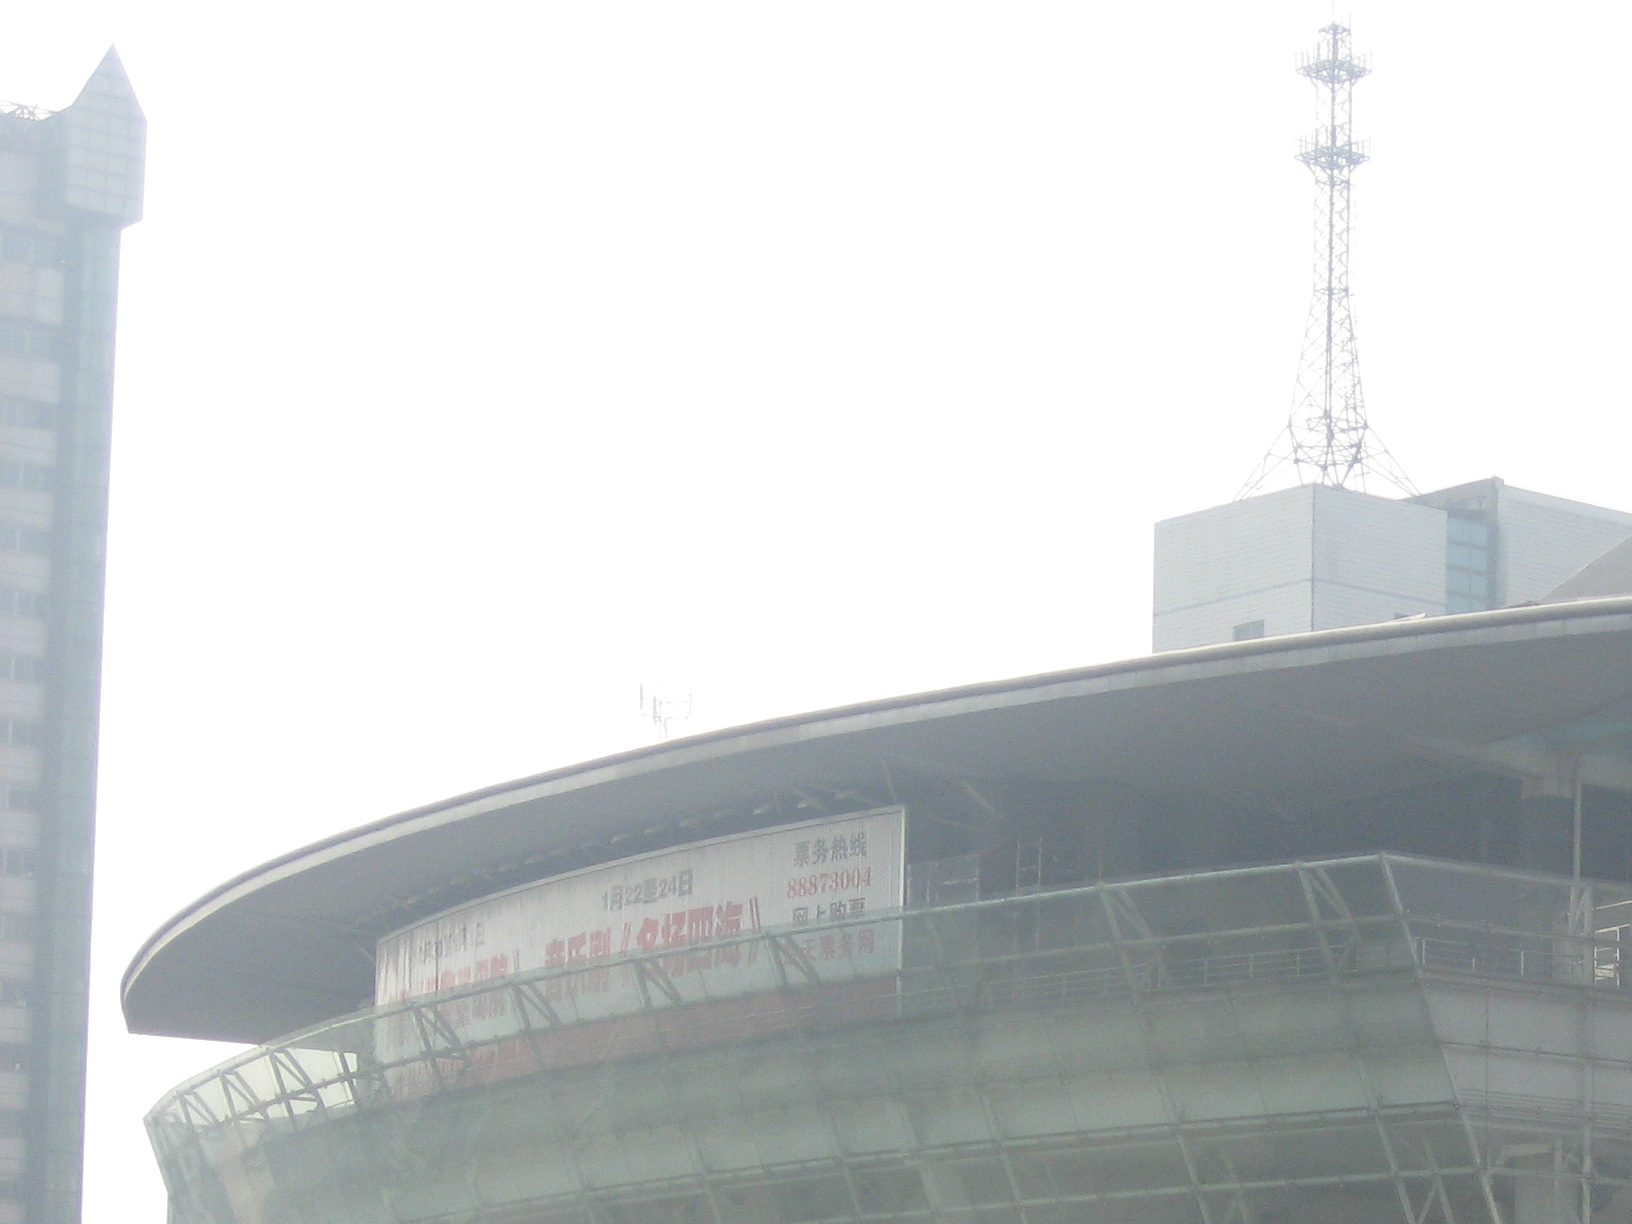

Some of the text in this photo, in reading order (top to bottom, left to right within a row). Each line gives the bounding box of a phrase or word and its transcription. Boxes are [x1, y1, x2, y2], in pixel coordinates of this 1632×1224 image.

[794, 832, 868, 867] 票务热线
[787, 867, 873, 898] 88873004
